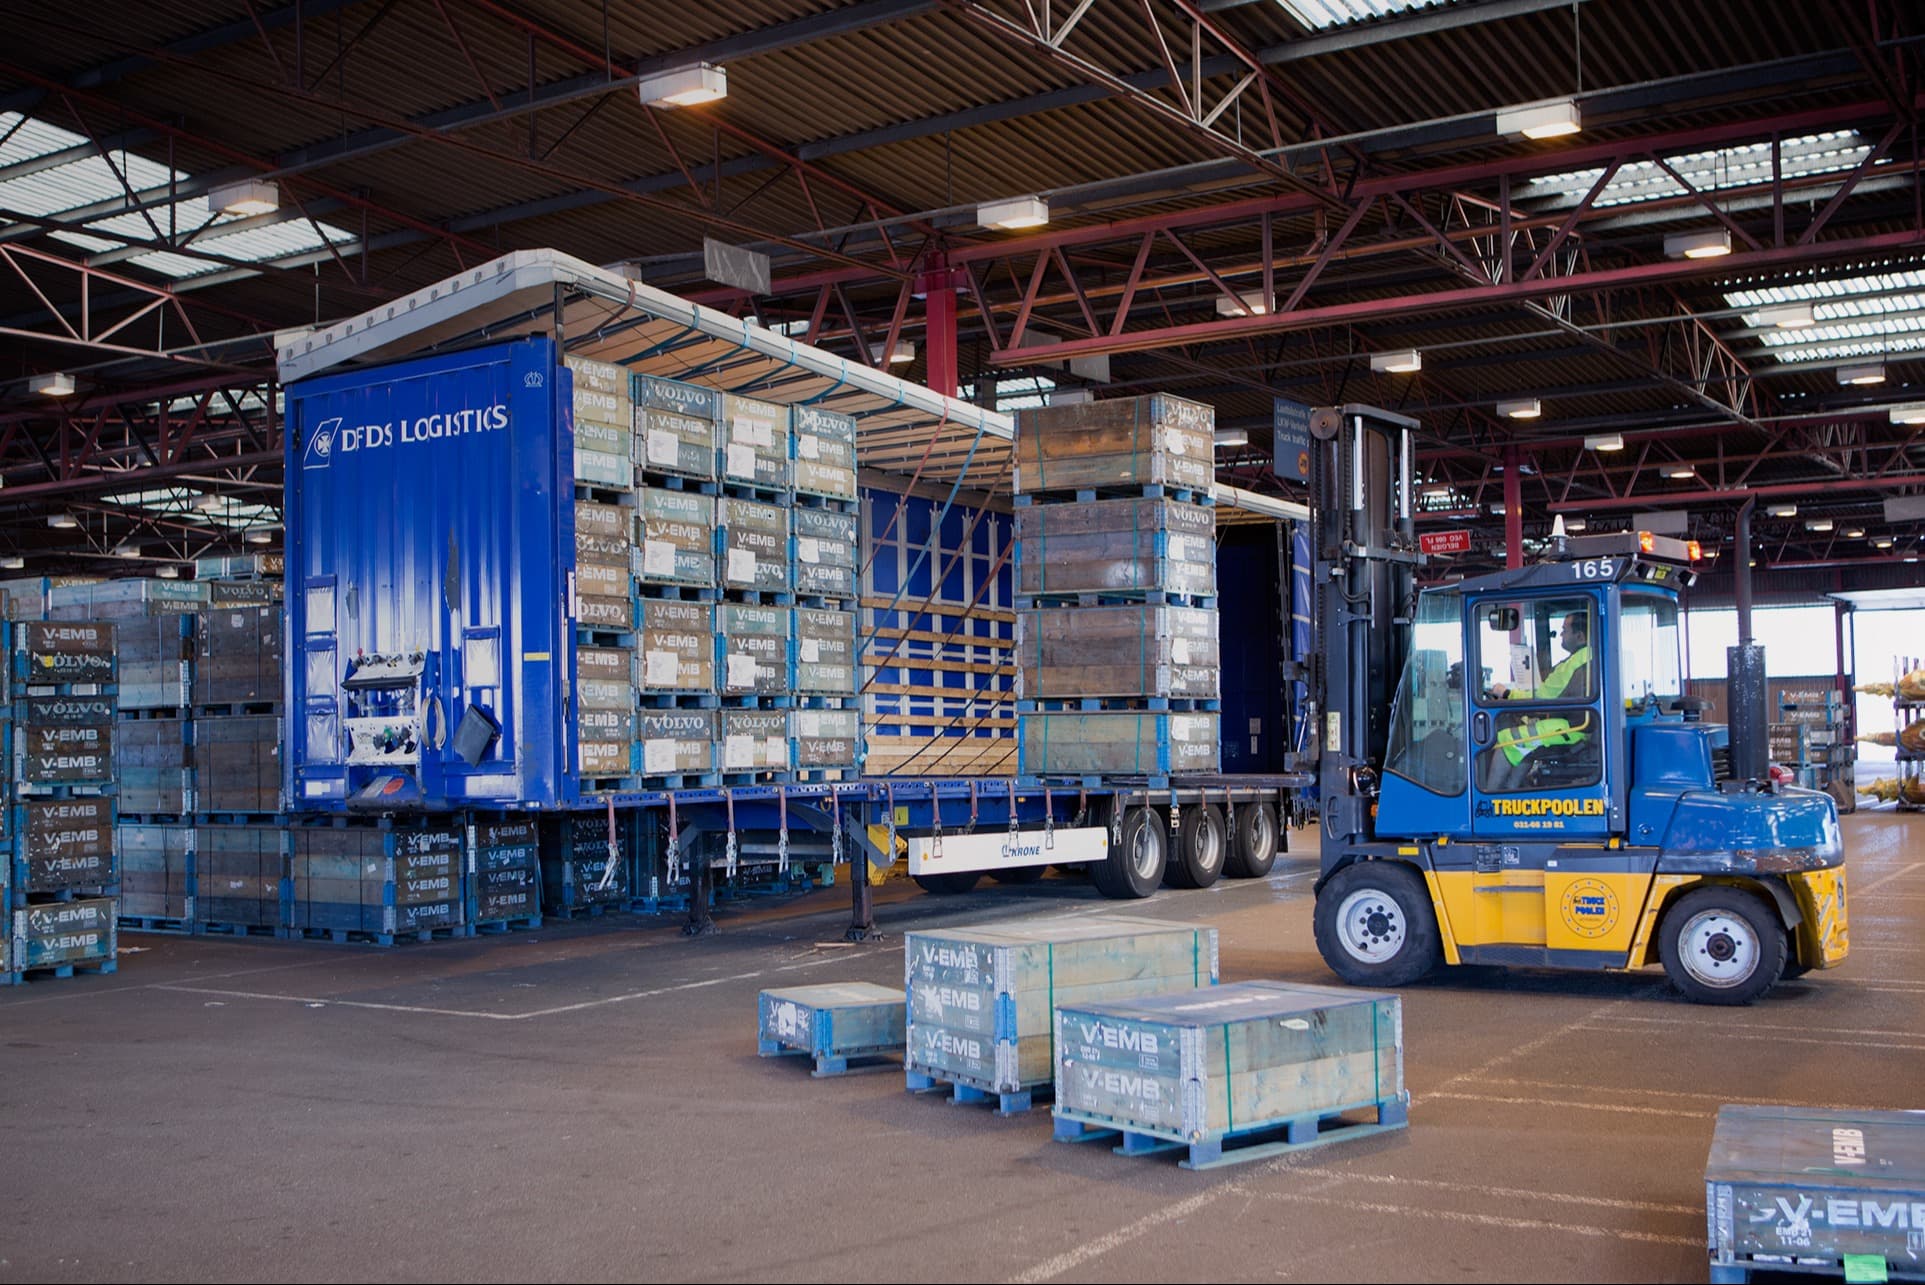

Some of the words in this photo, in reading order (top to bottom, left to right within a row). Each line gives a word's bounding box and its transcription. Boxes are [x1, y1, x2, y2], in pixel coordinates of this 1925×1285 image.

[655, 385, 706, 405] VOLVO
[341, 422, 393, 452] DFDS
[401, 405, 509, 443] LOGISTICS
[819, 441, 844, 455] EMB
[583, 453, 617, 468] EMB
[804, 513, 848, 529] VOLVO
[1172, 508, 1209, 524] VOLVO
[819, 541, 845, 555] EMB
[1571, 560, 1614, 579] 165
[581, 603, 621, 618] OLVO
[43, 627, 97, 640] V-EMB
[577, 652, 619, 666] -EMB
[37, 701, 105, 715] VOLVO
[577, 713, 619, 727] -EMB
[652, 715, 704, 729] VOLVO
[733, 715, 780, 728] VOLVO
[42, 729, 98, 741] V-EMB
[584, 744, 618, 757] EMB
[41, 756, 96, 769] V-EMB
[43, 805, 97, 818] V-EMB
[1491, 799, 1605, 816] TRUCKPOOLEN
[1011, 846, 1040, 857] KRONE
[45, 857, 99, 871] V-EMB
[408, 854, 449, 867] V-EMB
[408, 877, 449, 891] V-EMB
[408, 904, 449, 918] V-EMB
[43, 934, 98, 950] V-EMB
[922, 943, 978, 970] V-EMB
[925, 1030, 980, 1059] V-EMB
[1080, 1023, 1159, 1054] V-EMB
[1081, 1068, 1160, 1101] V-EMB
